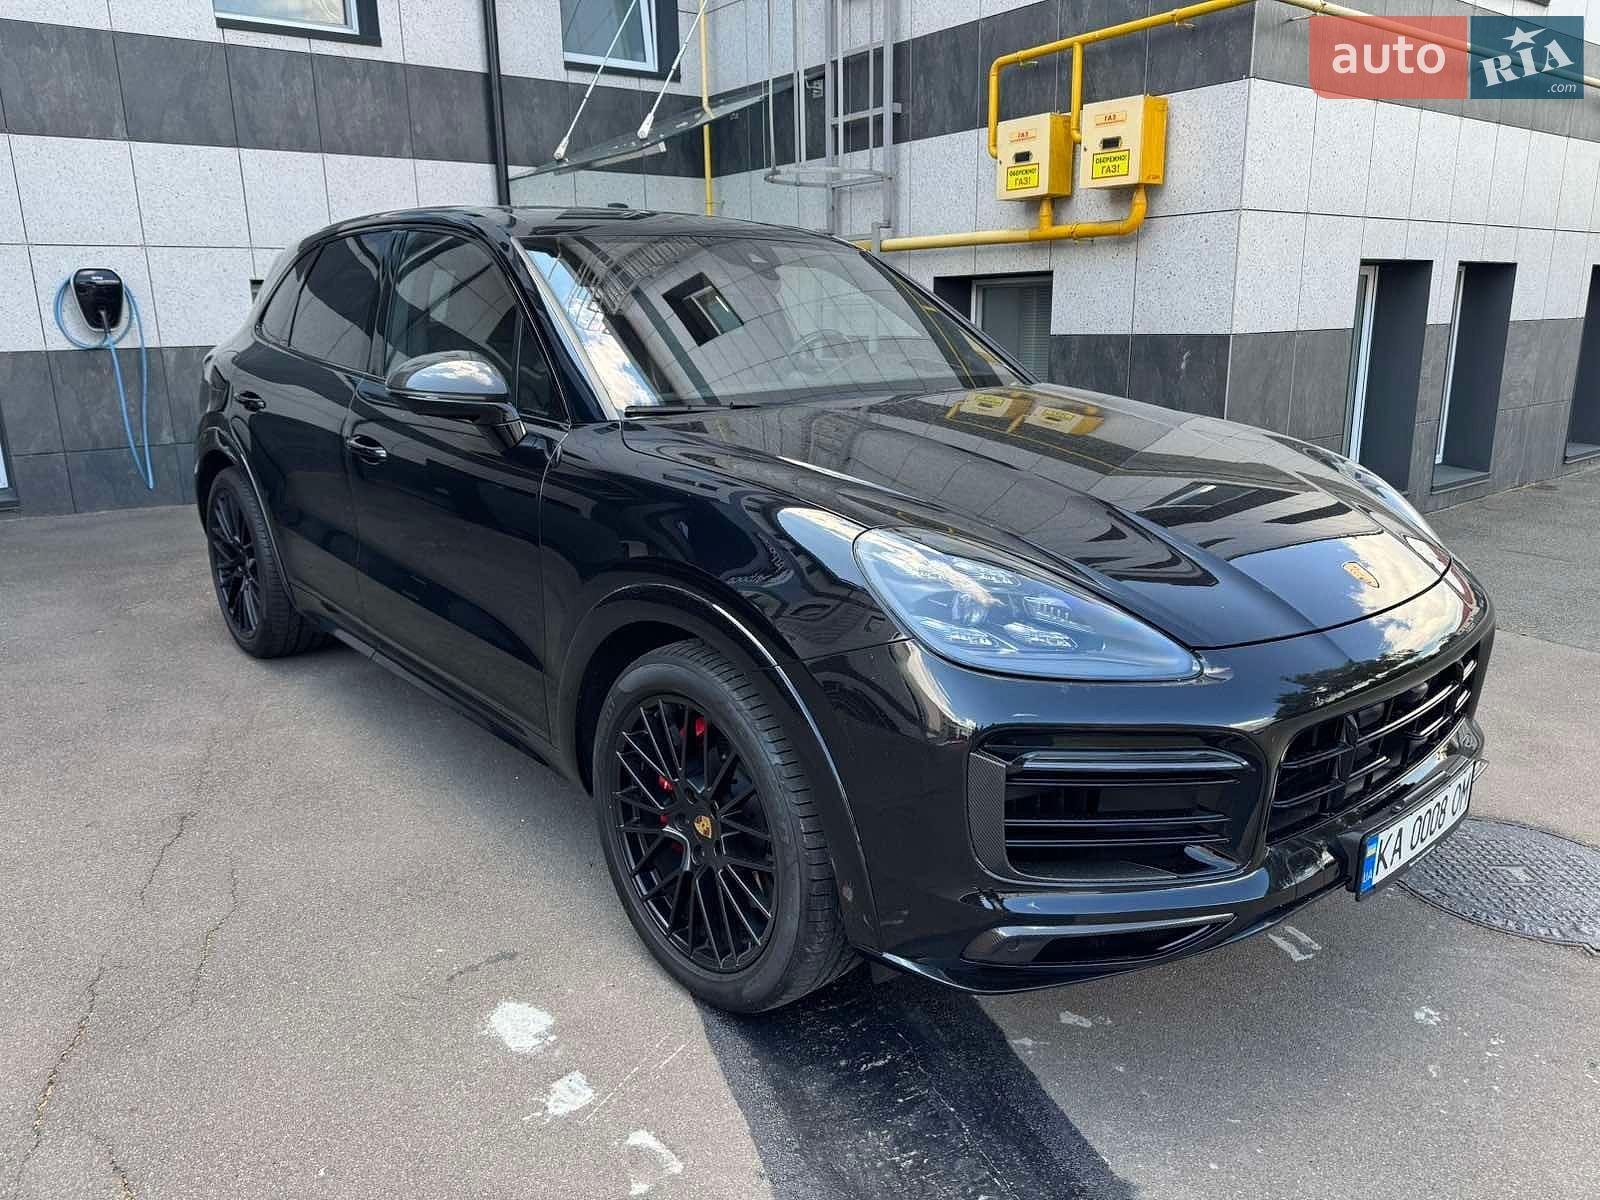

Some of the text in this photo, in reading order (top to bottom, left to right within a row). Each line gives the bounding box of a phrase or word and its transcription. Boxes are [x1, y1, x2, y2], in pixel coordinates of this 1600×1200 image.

[1101, 164, 1120, 175] ГАЗ!
[1014, 176, 1031, 186] ГАЗ!
[1375, 827, 1403, 876] KA
[1410, 795, 1449, 851] 0008
[1361, 867, 1373, 884] UA
